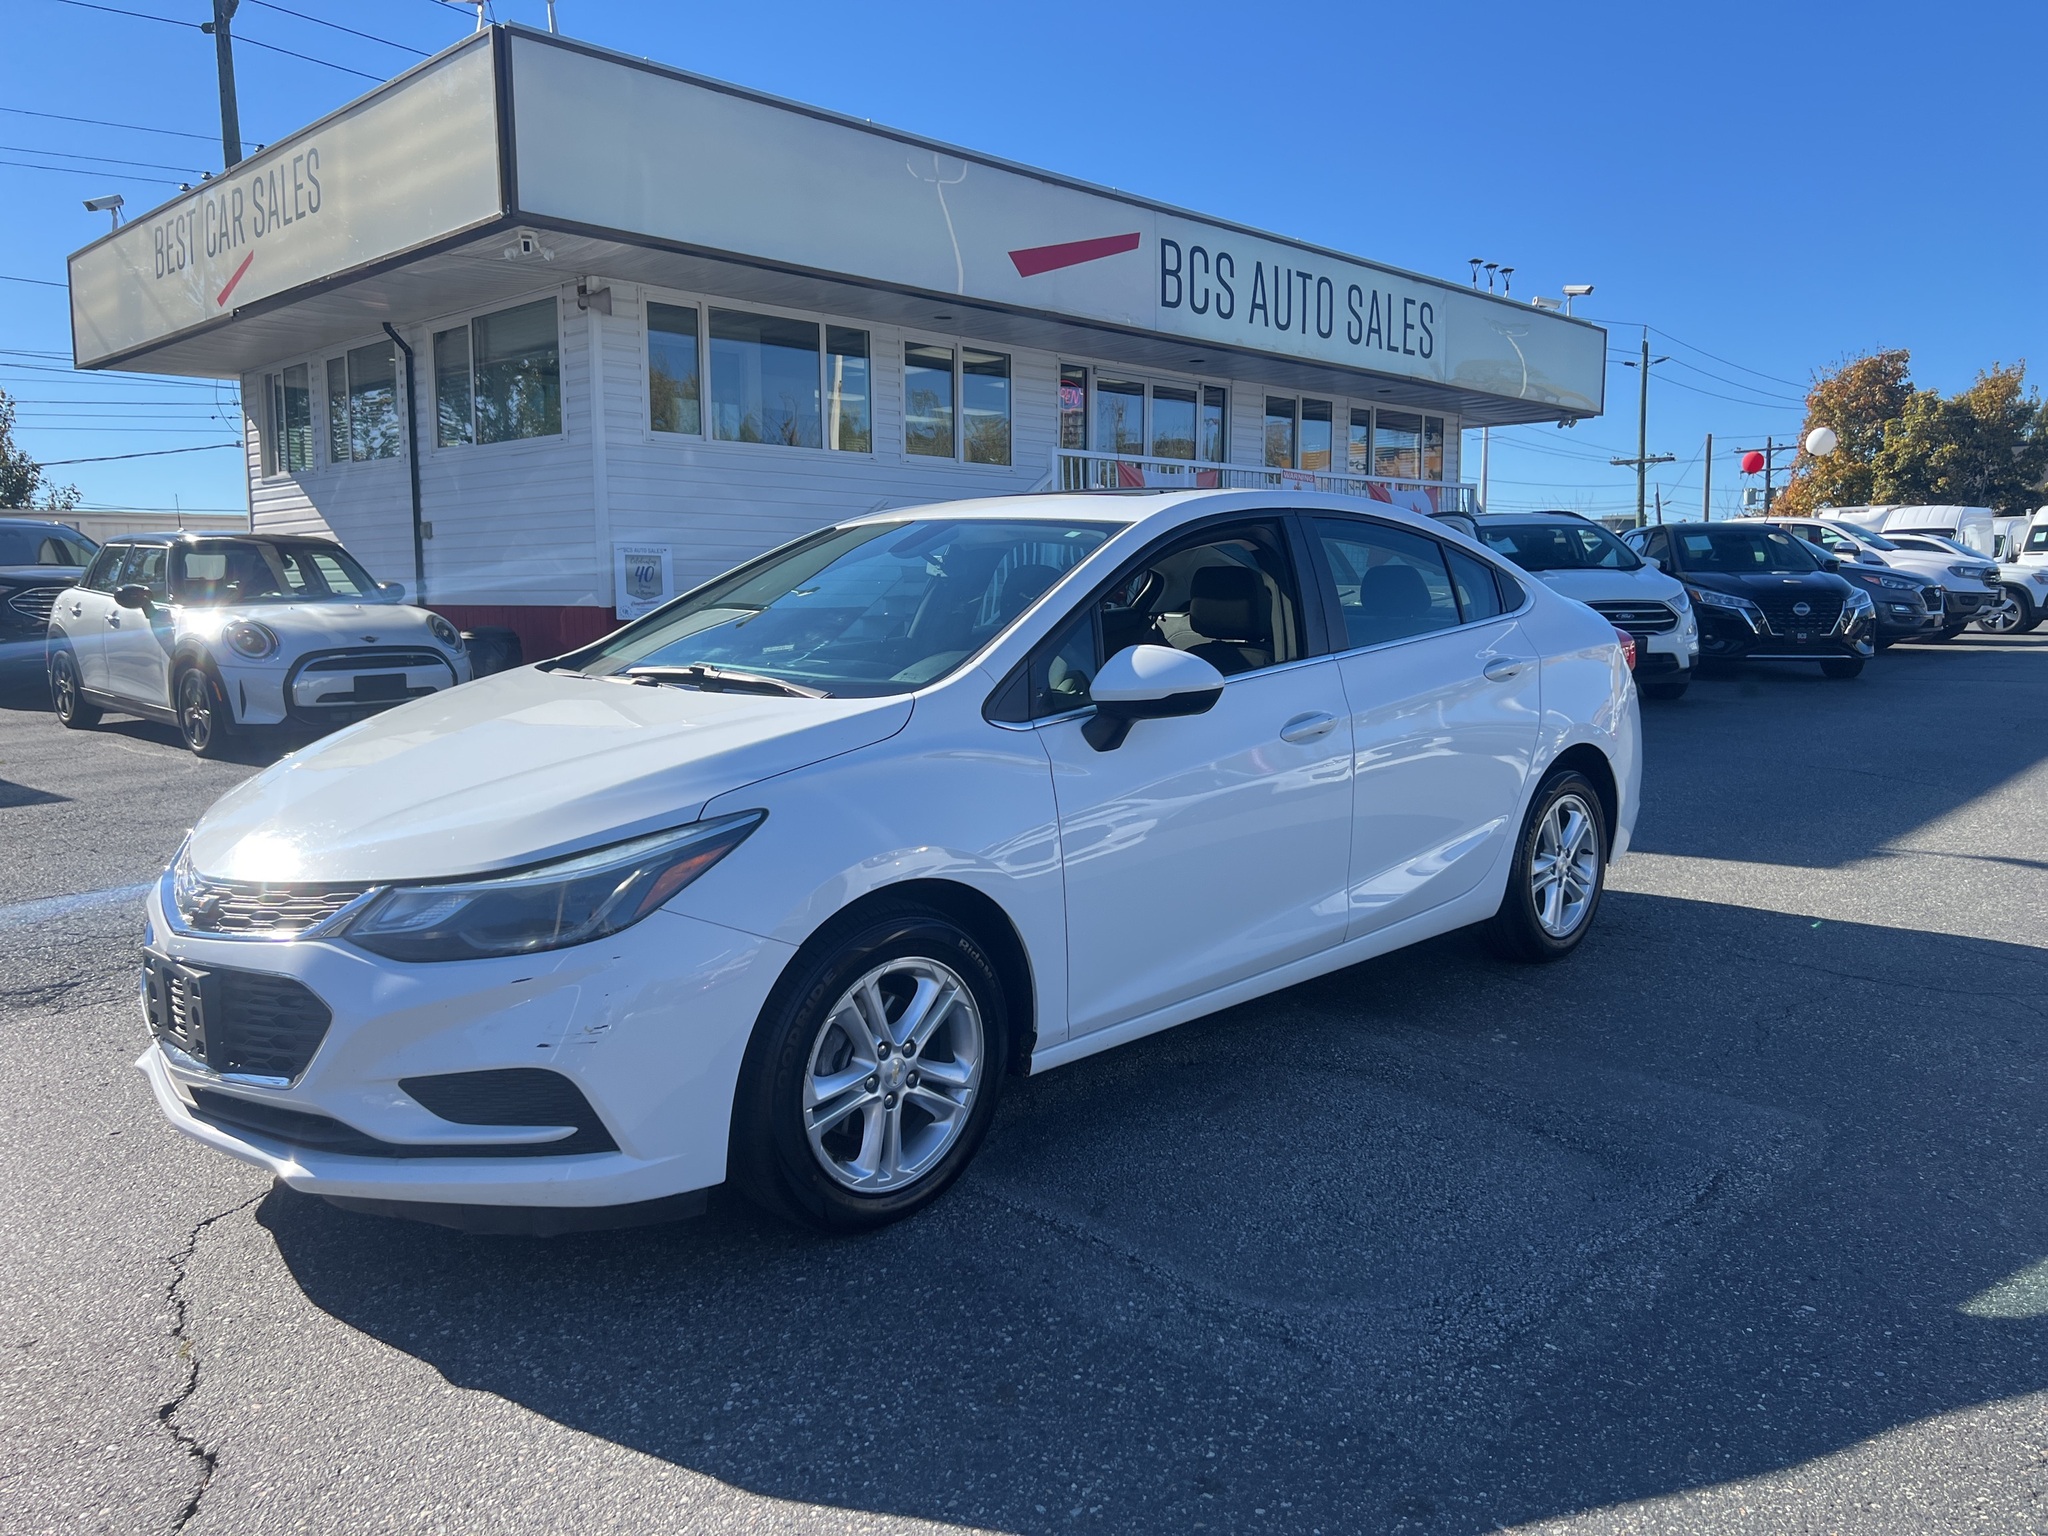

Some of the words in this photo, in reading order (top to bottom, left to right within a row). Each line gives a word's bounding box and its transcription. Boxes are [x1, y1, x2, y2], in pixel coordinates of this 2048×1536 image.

[155, 207, 196, 279] BEST
[205, 187, 245, 258] CAR
[252, 147, 321, 238] SALES
[1161, 238, 1235, 319] BCS
[1249, 261, 1334, 339] AUTO
[1347, 284, 1434, 359] SALES
[1060, 387, 1080, 404] PEN
[1283, 471, 1314, 482] WARNING
[635, 565, 655, 583] 40
